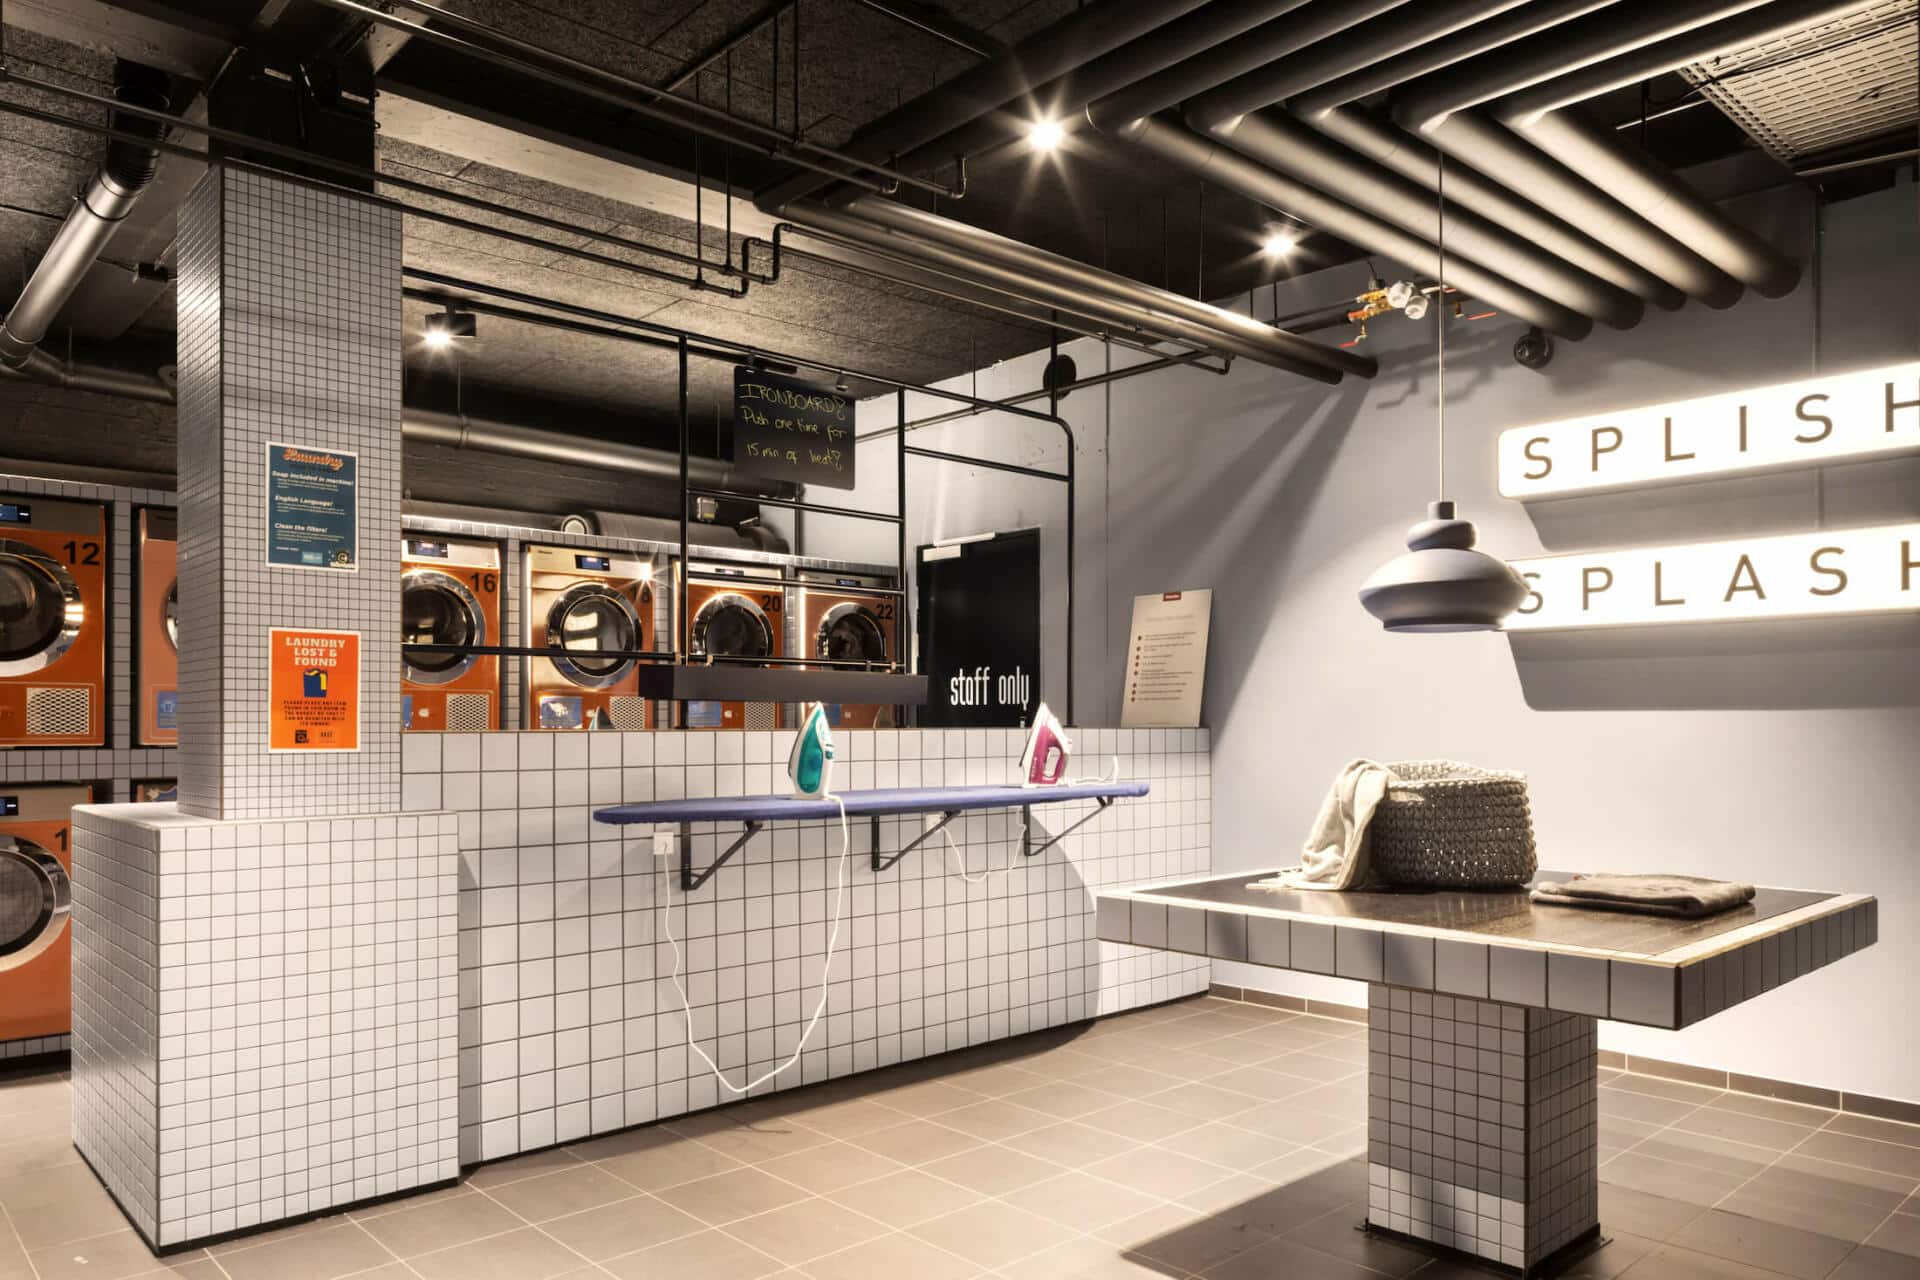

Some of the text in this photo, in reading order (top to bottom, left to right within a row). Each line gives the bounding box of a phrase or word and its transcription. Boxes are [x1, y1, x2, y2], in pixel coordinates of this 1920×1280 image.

[1522, 376, 1920, 481] SPLISH
[746, 442, 760, 456] 15
[63, 541, 100, 566] 12
[470, 572, 497, 593] 16
[1515, 540, 1920, 615] SPLASH
[762, 596, 782, 612] 20
[876, 603, 894, 620] 22
[286, 636, 346, 648] LAUNDRY
[294, 648, 326, 656] LOST
[294, 658, 336, 666] FOUND
[950, 665, 1030, 711] staff only
[54, 827, 69, 852] 1
